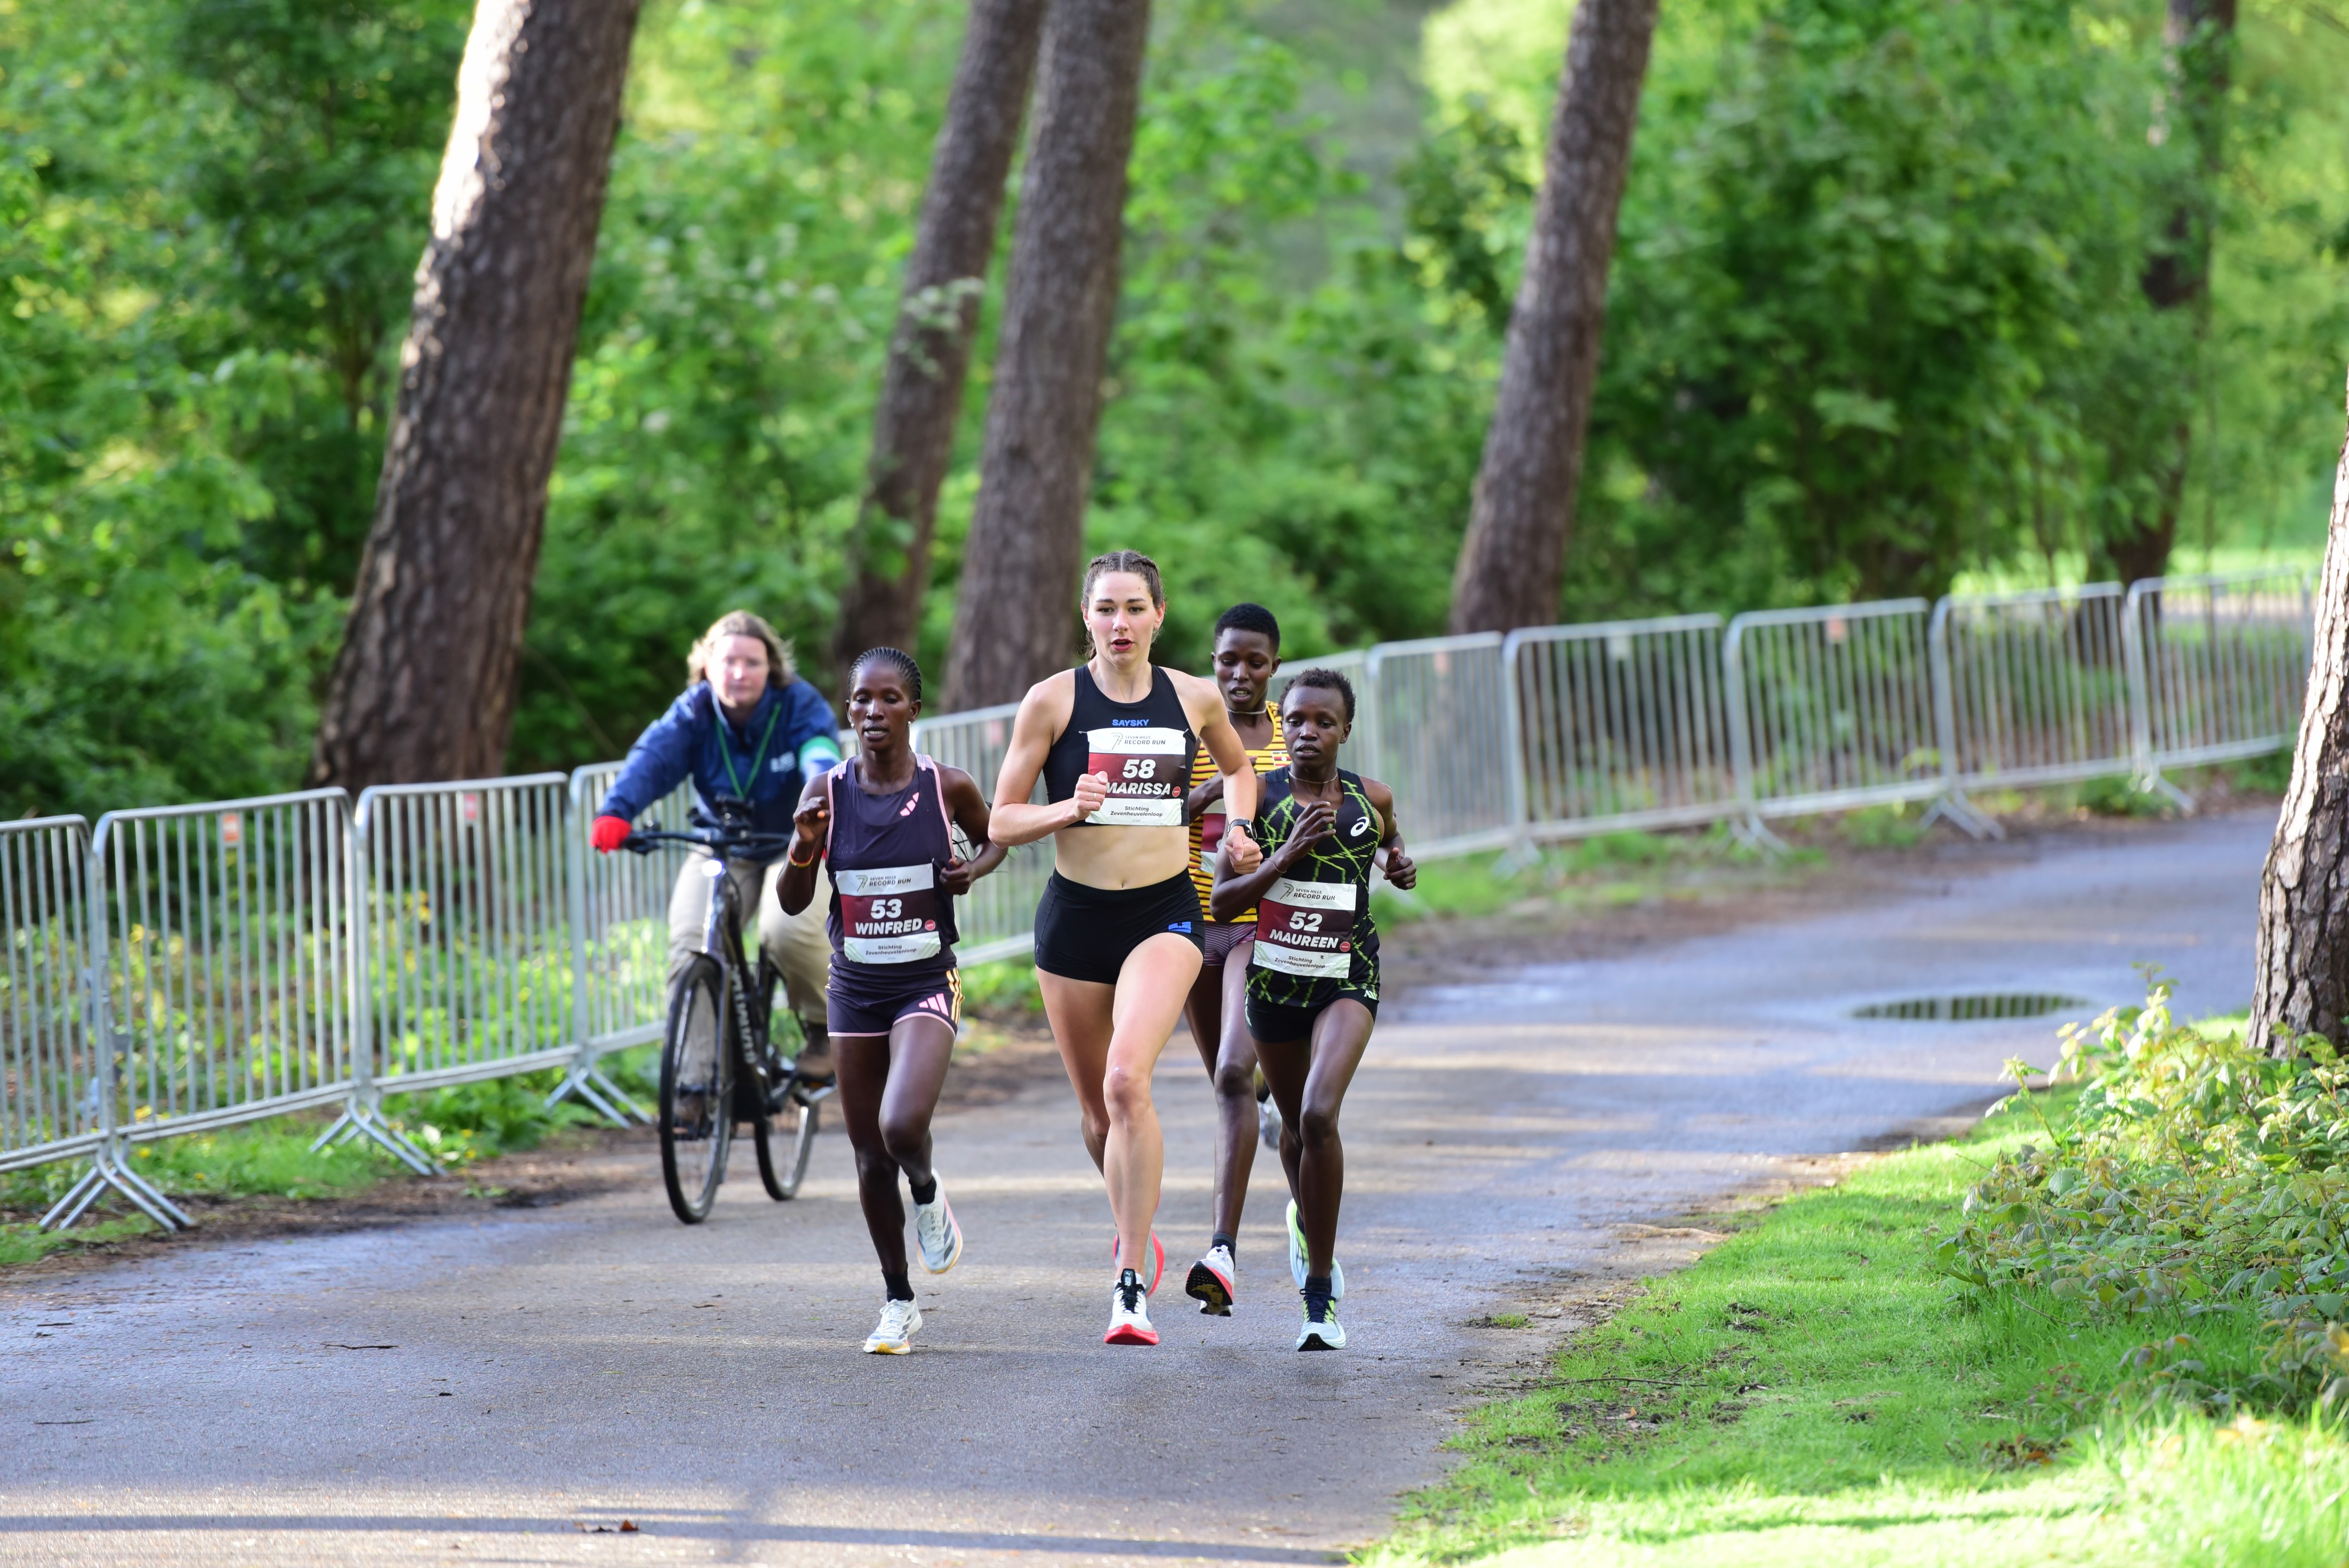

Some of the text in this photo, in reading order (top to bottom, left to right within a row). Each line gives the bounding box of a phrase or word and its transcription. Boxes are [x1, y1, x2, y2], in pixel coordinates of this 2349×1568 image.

[1122, 759, 1156, 779] 58
[1106, 782, 1171, 795] MARISSA
[870, 898, 902, 919] 53
[855, 918, 923, 935] WINFRED
[1289, 911, 1323, 932] 52
[1269, 929, 1339, 949] MAUREEN
[1274, 957, 1326, 969] Zevenheuvelenloop
[1288, 955, 1313, 964] Stichting
